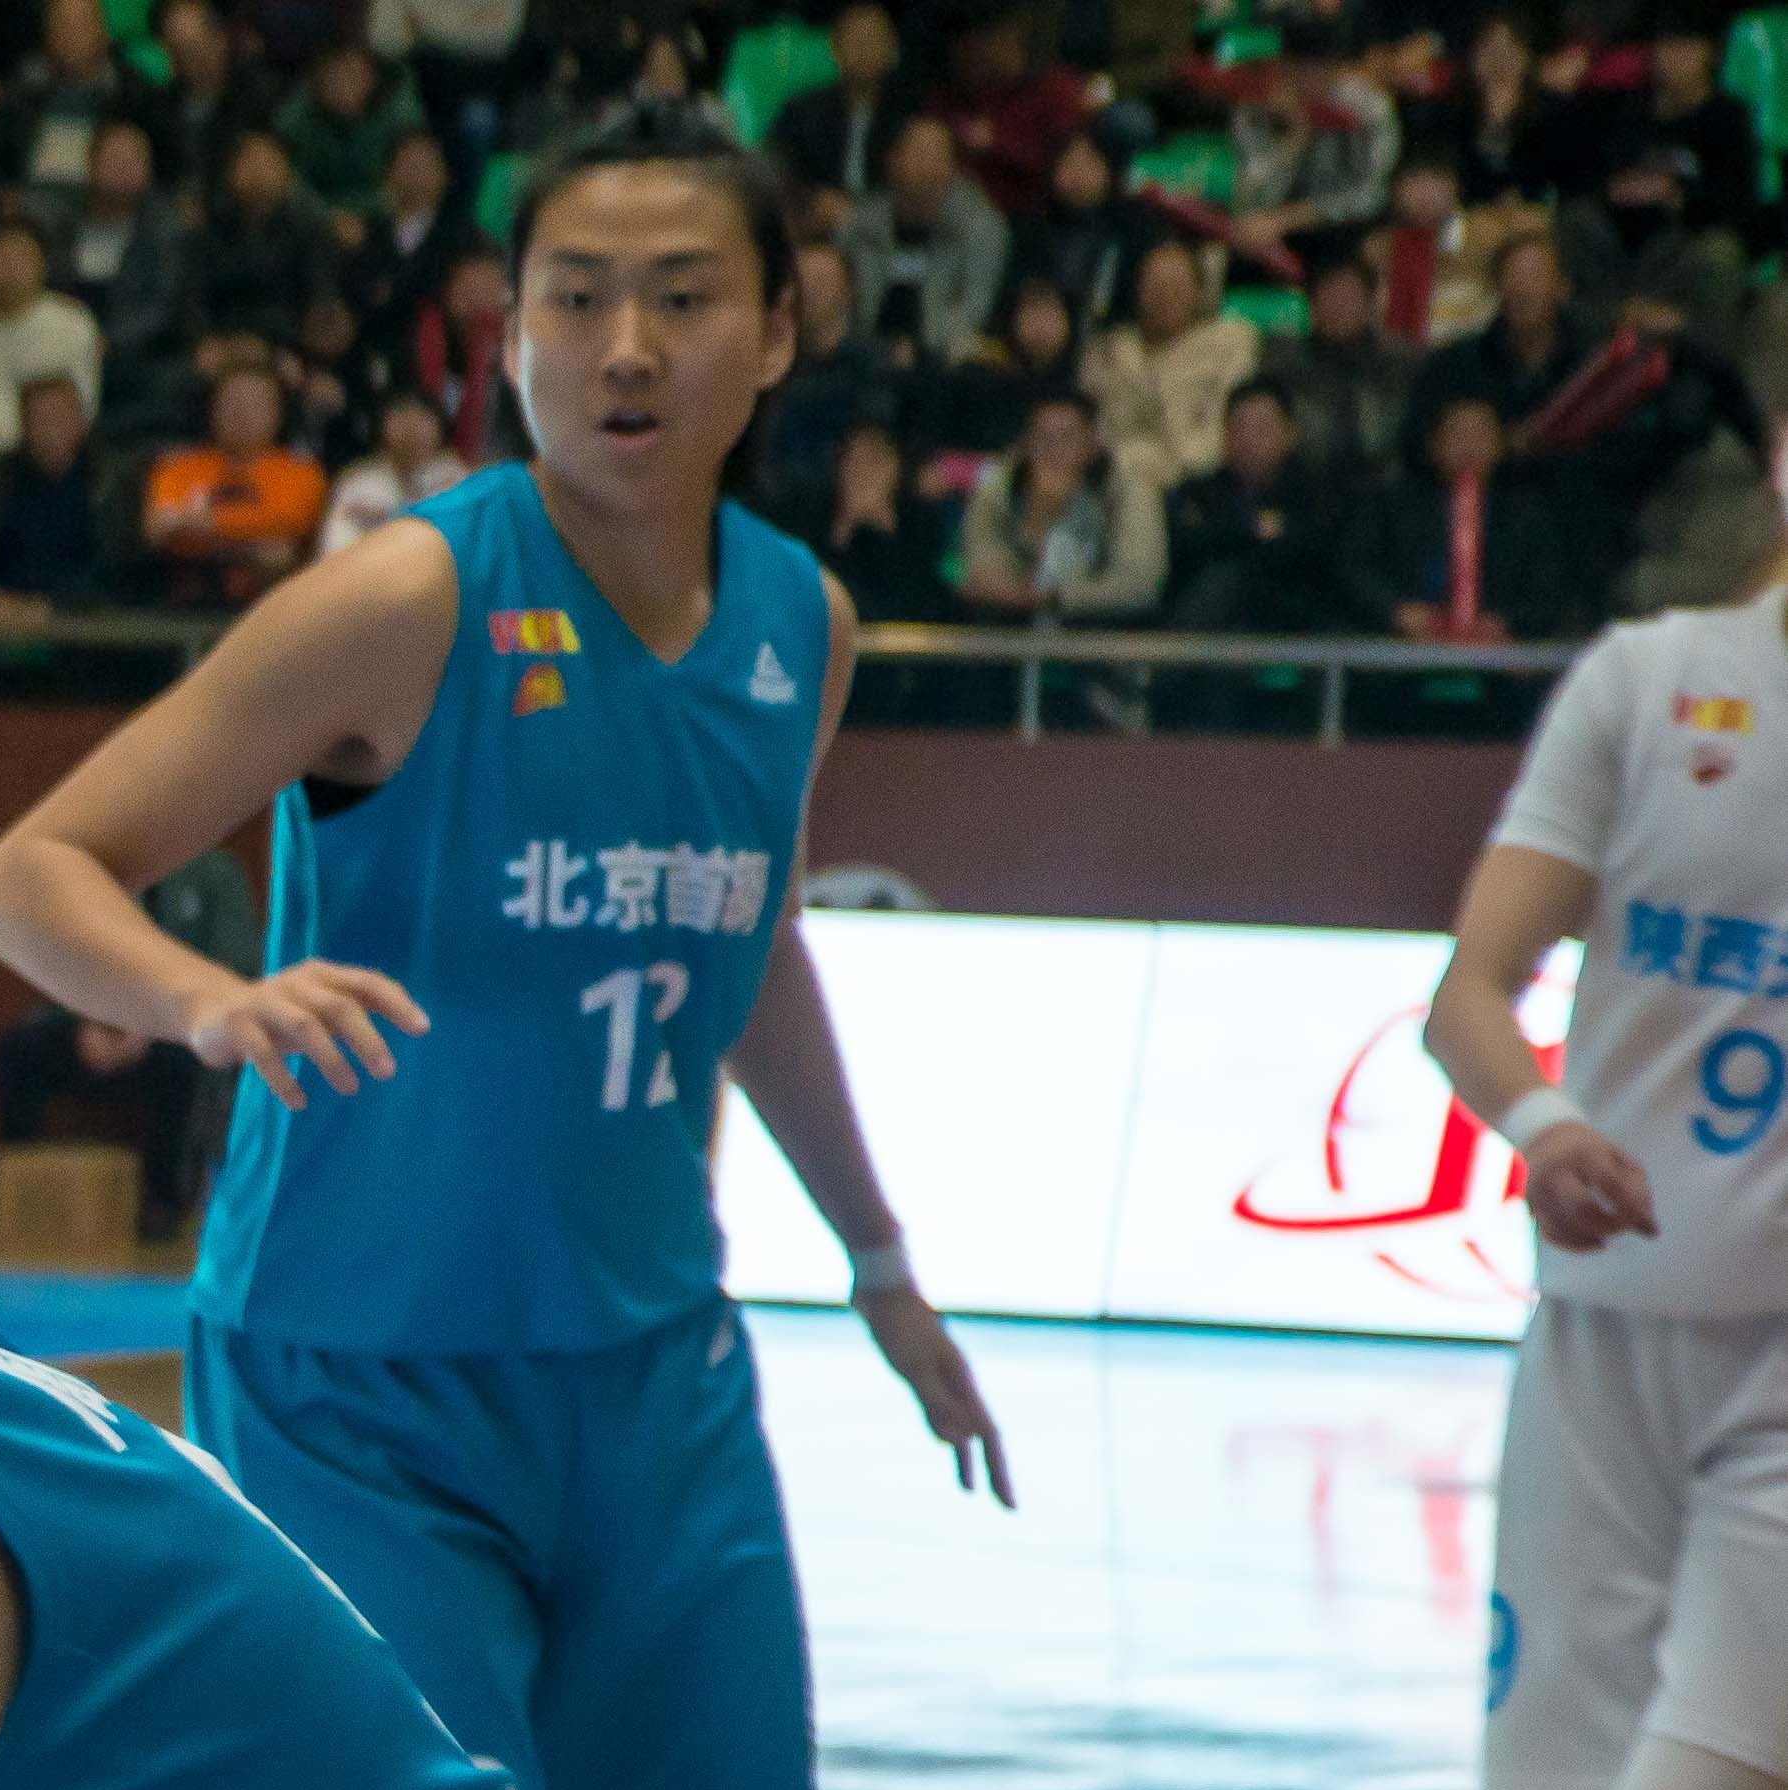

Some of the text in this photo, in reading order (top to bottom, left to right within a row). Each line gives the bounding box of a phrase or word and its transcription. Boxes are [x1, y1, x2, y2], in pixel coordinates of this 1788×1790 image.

[1623, 897, 1788, 998] 陕西
[580, 959, 689, 1113] 12
[1689, 1028, 1785, 1156] 9
